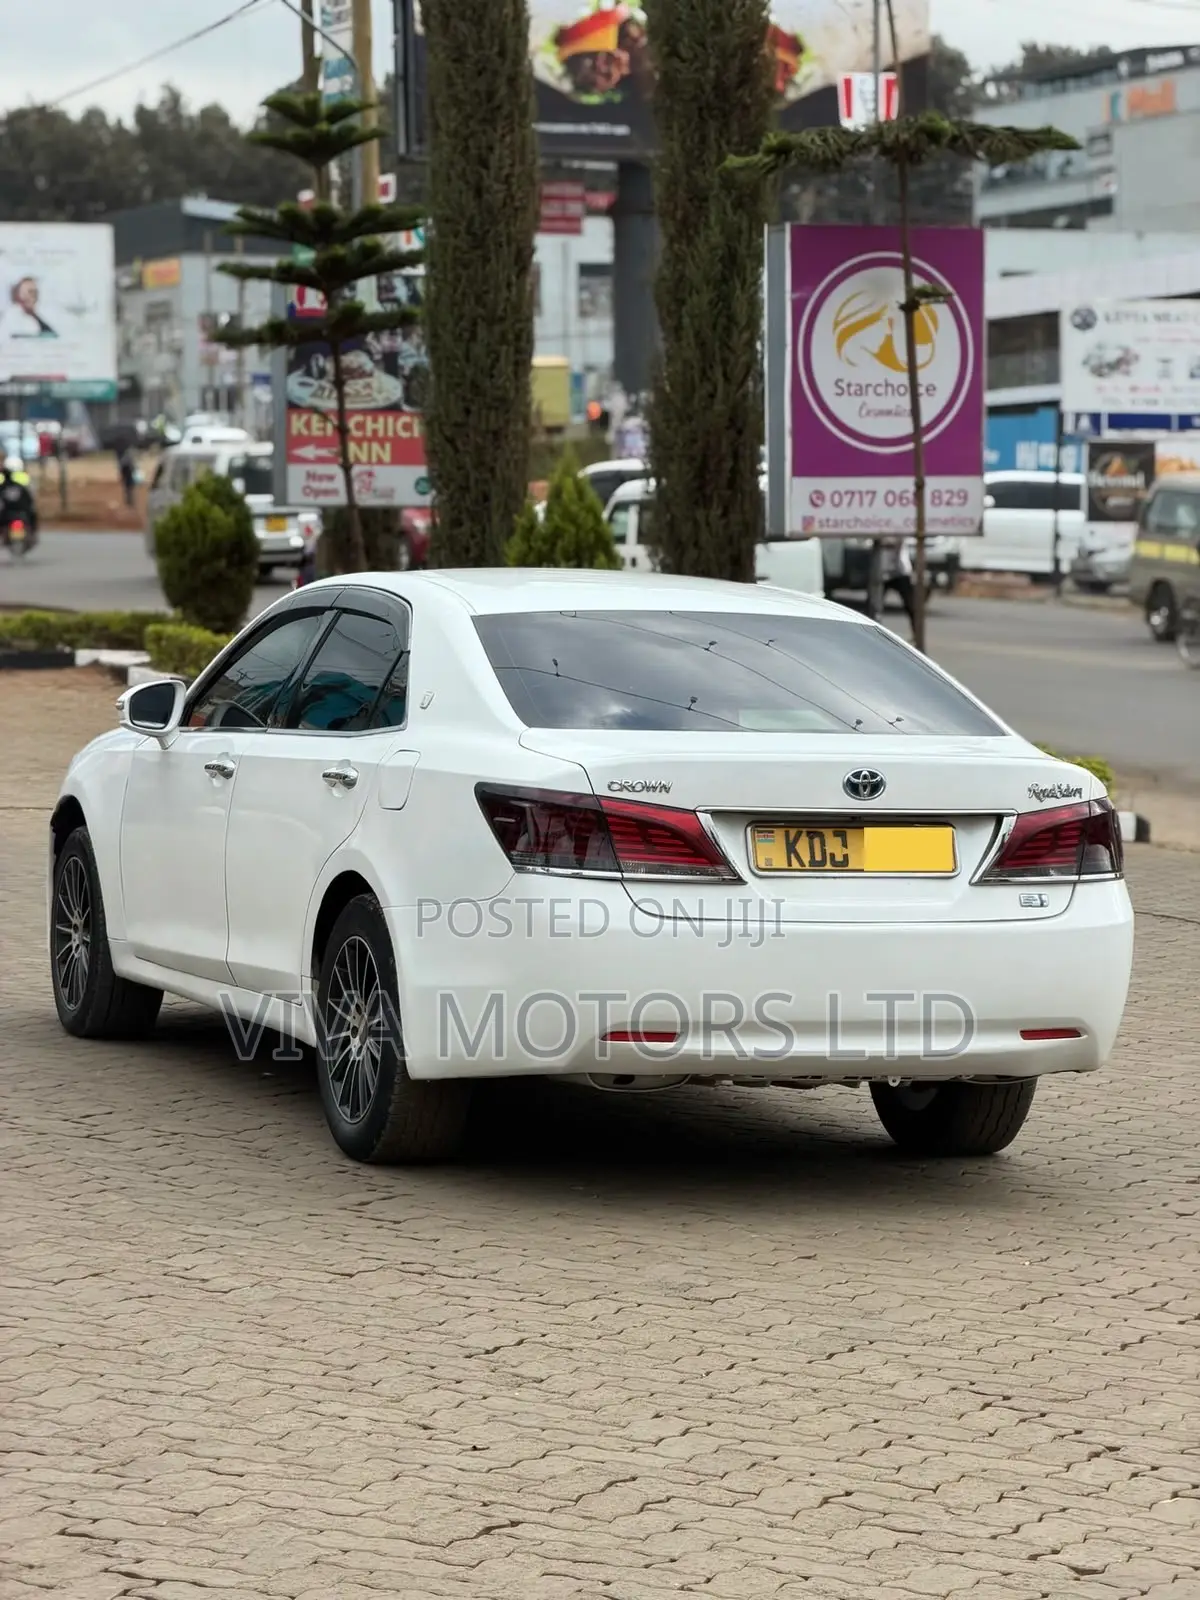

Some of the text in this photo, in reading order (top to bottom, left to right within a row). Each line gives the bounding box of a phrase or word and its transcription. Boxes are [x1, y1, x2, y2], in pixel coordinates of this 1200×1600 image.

[834, 378, 937, 397] Starchoce
[340, 441, 392, 464] NN
[302, 485, 340, 500] Open
[830, 489, 877, 508] 0717
[930, 489, 969, 508] 829
[607, 778, 673, 794] CROWN
[784, 829, 849, 868] KDJ
